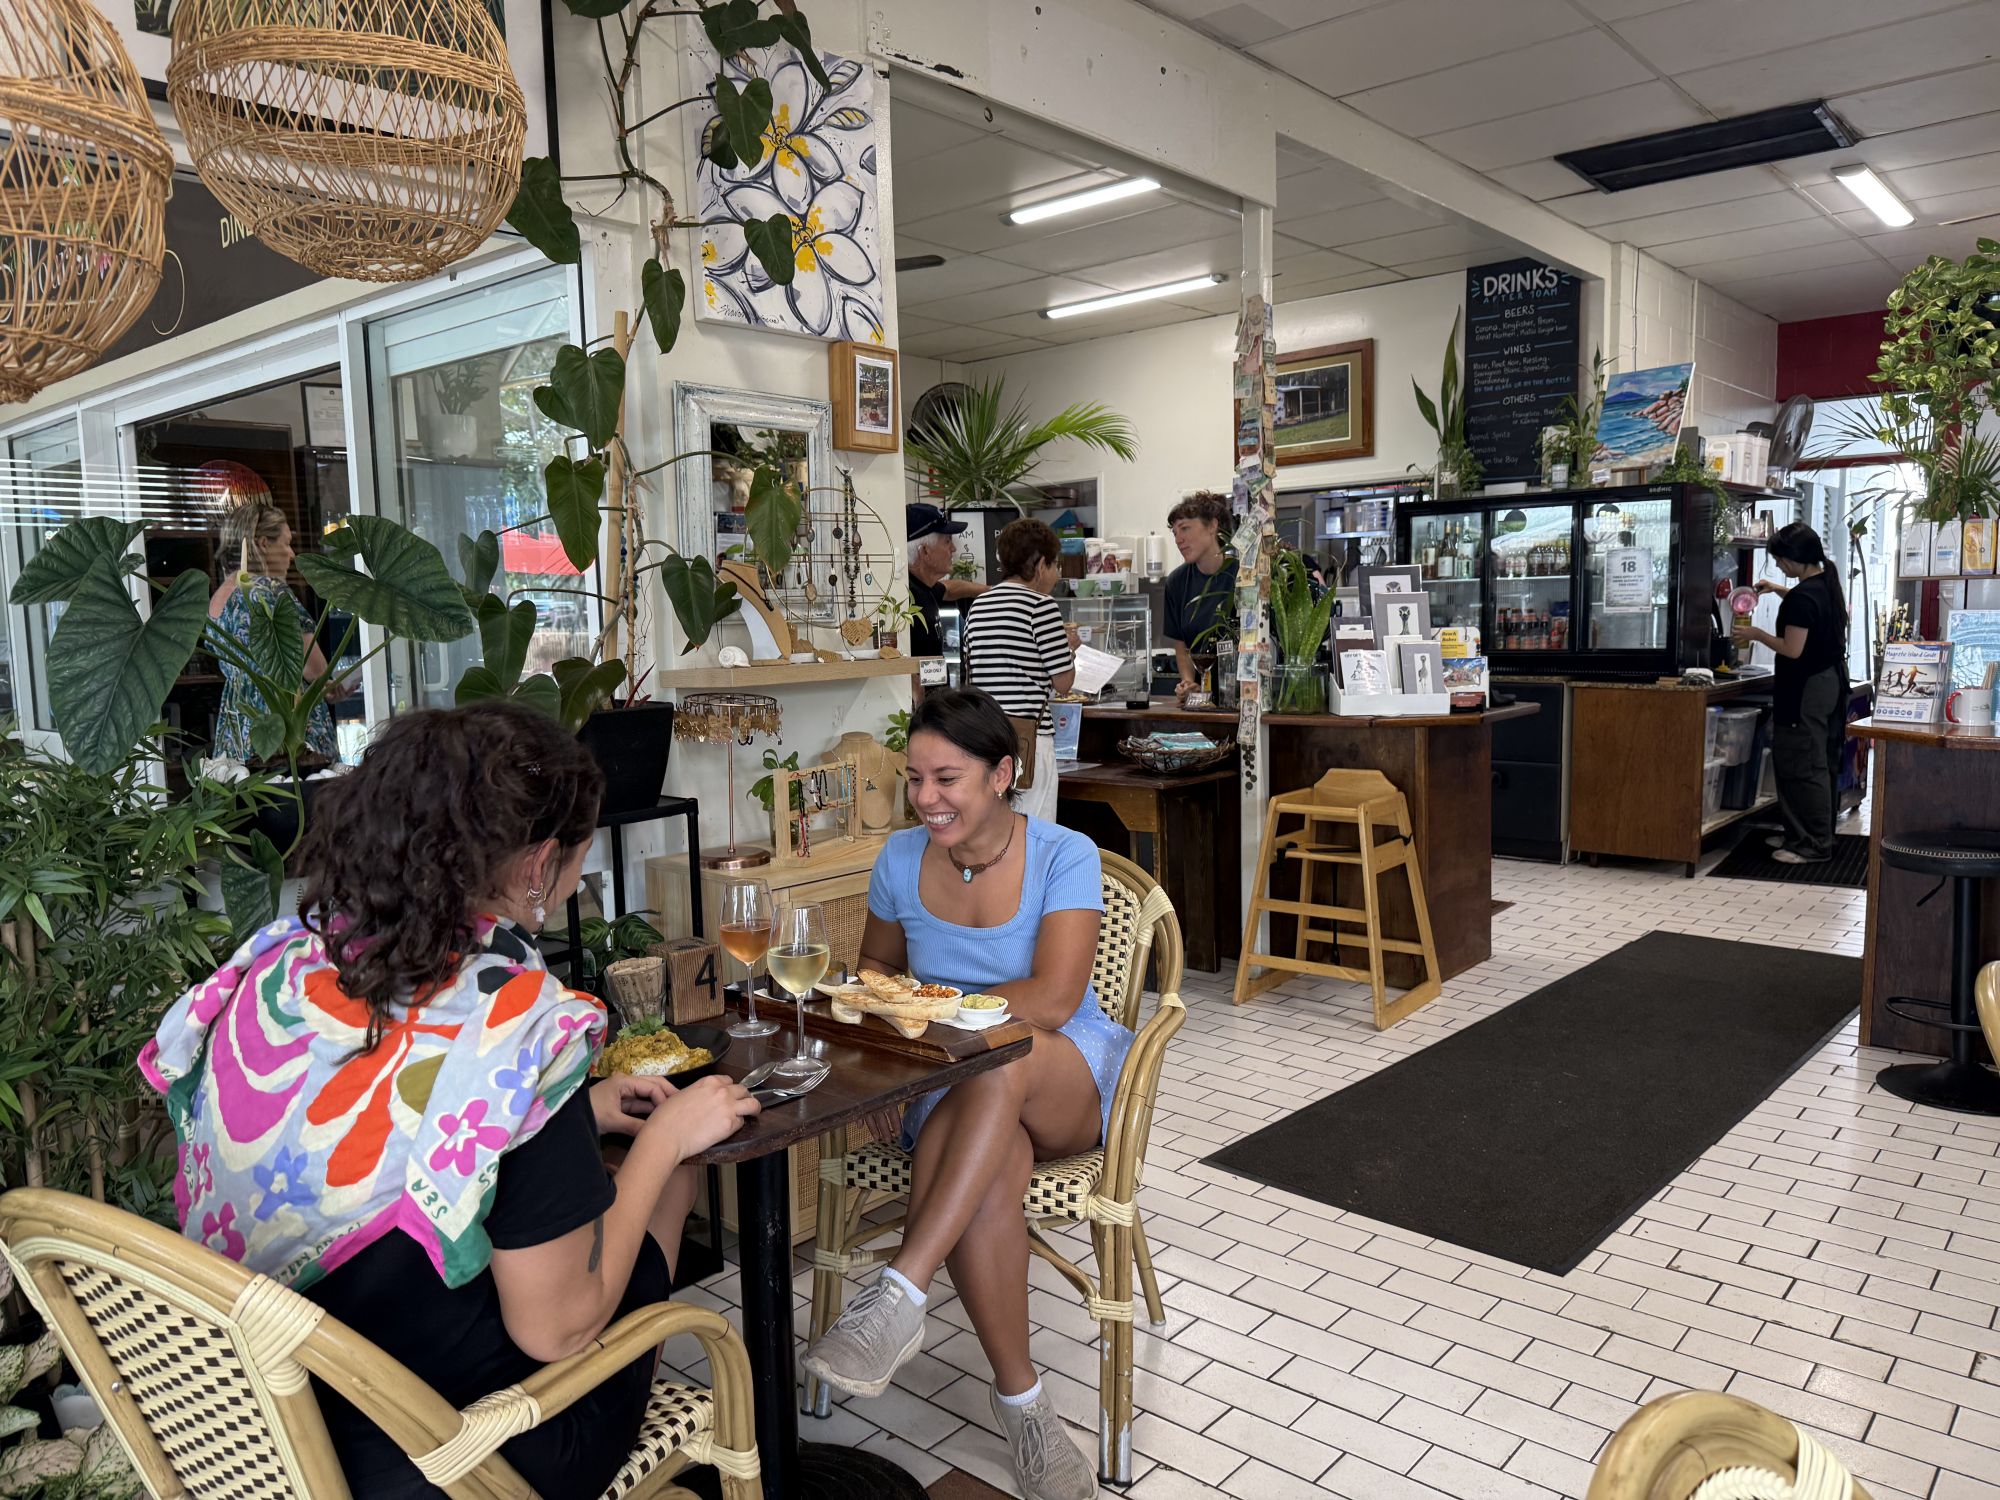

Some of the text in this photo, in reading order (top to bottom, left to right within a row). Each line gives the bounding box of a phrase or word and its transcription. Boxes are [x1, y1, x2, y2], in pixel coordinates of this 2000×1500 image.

[1483, 266, 1558, 297] DRINKS
[1483, 288, 1558, 304] AFTER 10AM
[1504, 304, 1535, 318] BEERS
[1503, 343, 1531, 355] WINES
[1502, 393, 1536, 405] OTHERS
[1505, 455, 1519, 464] Bay
[958, 529, 1003, 539] AM P
[1620, 561, 1637, 573] 18
[695, 953, 717, 1001] 4
